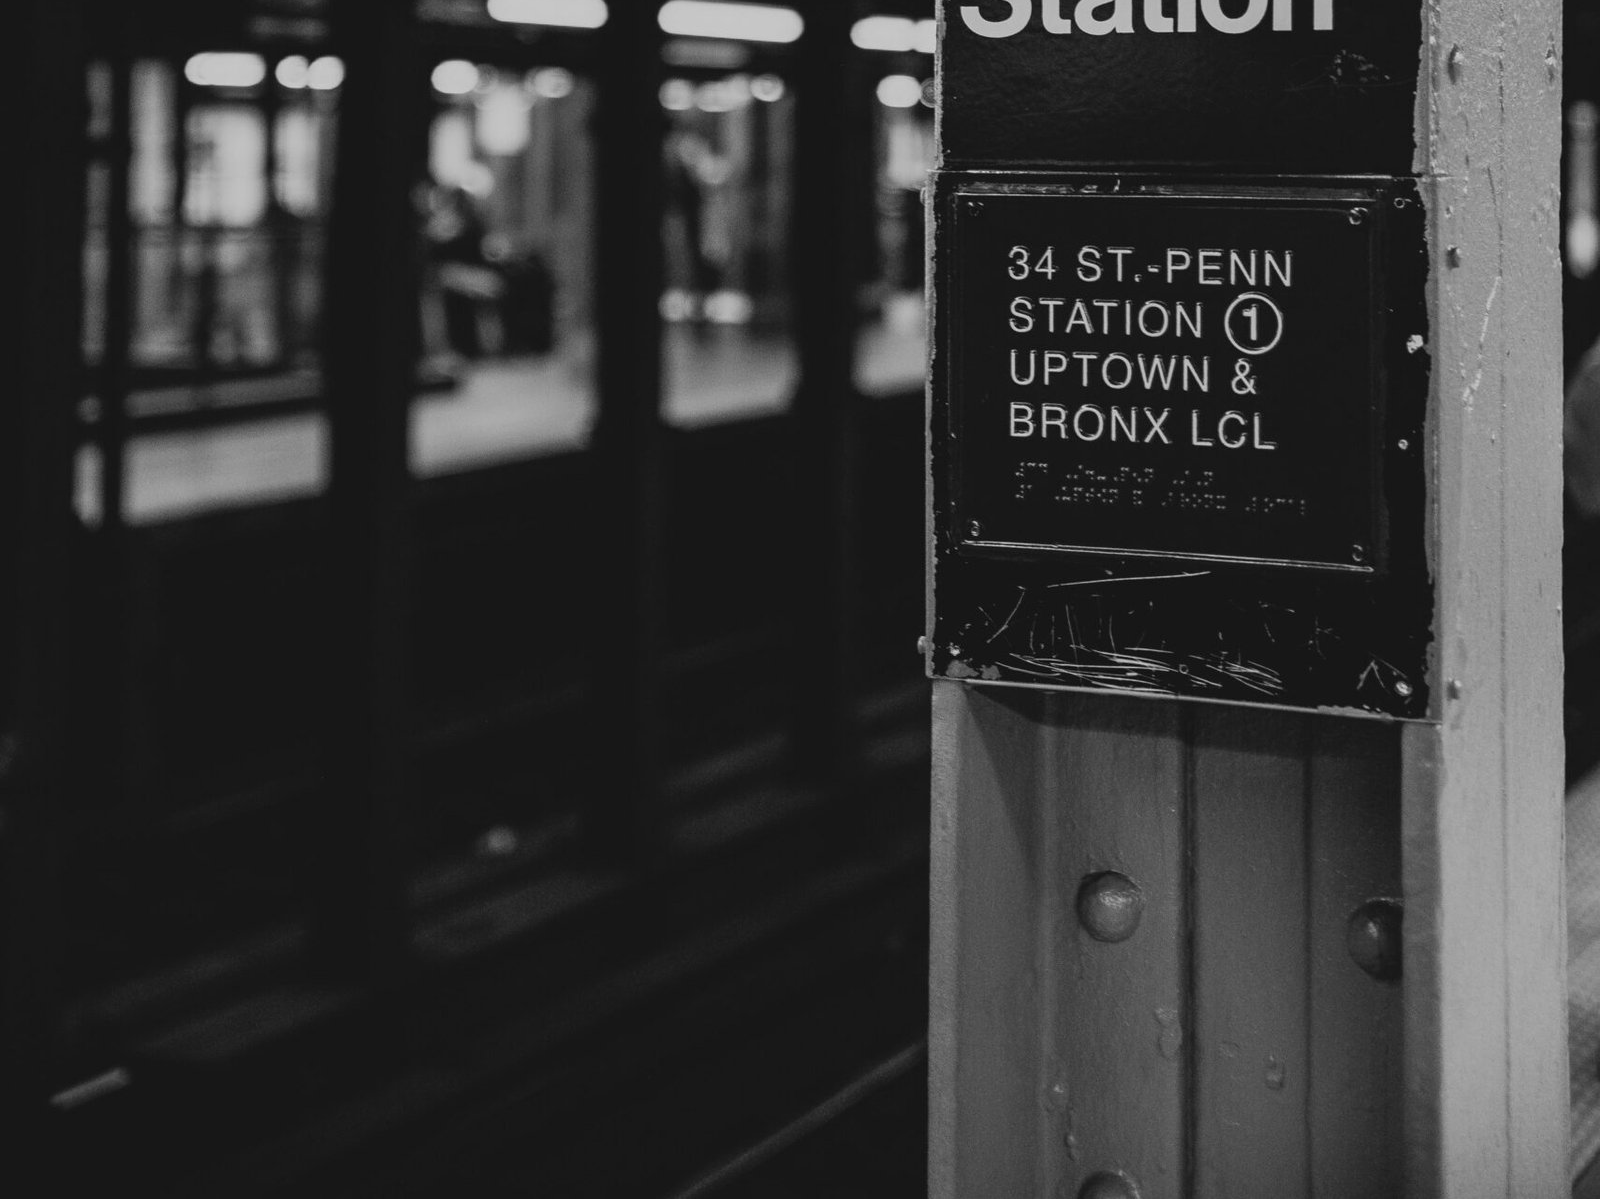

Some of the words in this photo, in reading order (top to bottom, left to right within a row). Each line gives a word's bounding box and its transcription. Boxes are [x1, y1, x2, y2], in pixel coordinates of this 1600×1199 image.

[1007, 245, 1057, 282] 34
[1077, 245, 1293, 288] ST.-PENN
[1009, 296, 1203, 339] STATION
[1242, 302, 1260, 343] 1
[1010, 349, 1211, 394] UPTOWN
[1231, 359, 1258, 396] &
[1010, 402, 1173, 446] BRONX
[1191, 410, 1280, 452] LCL
